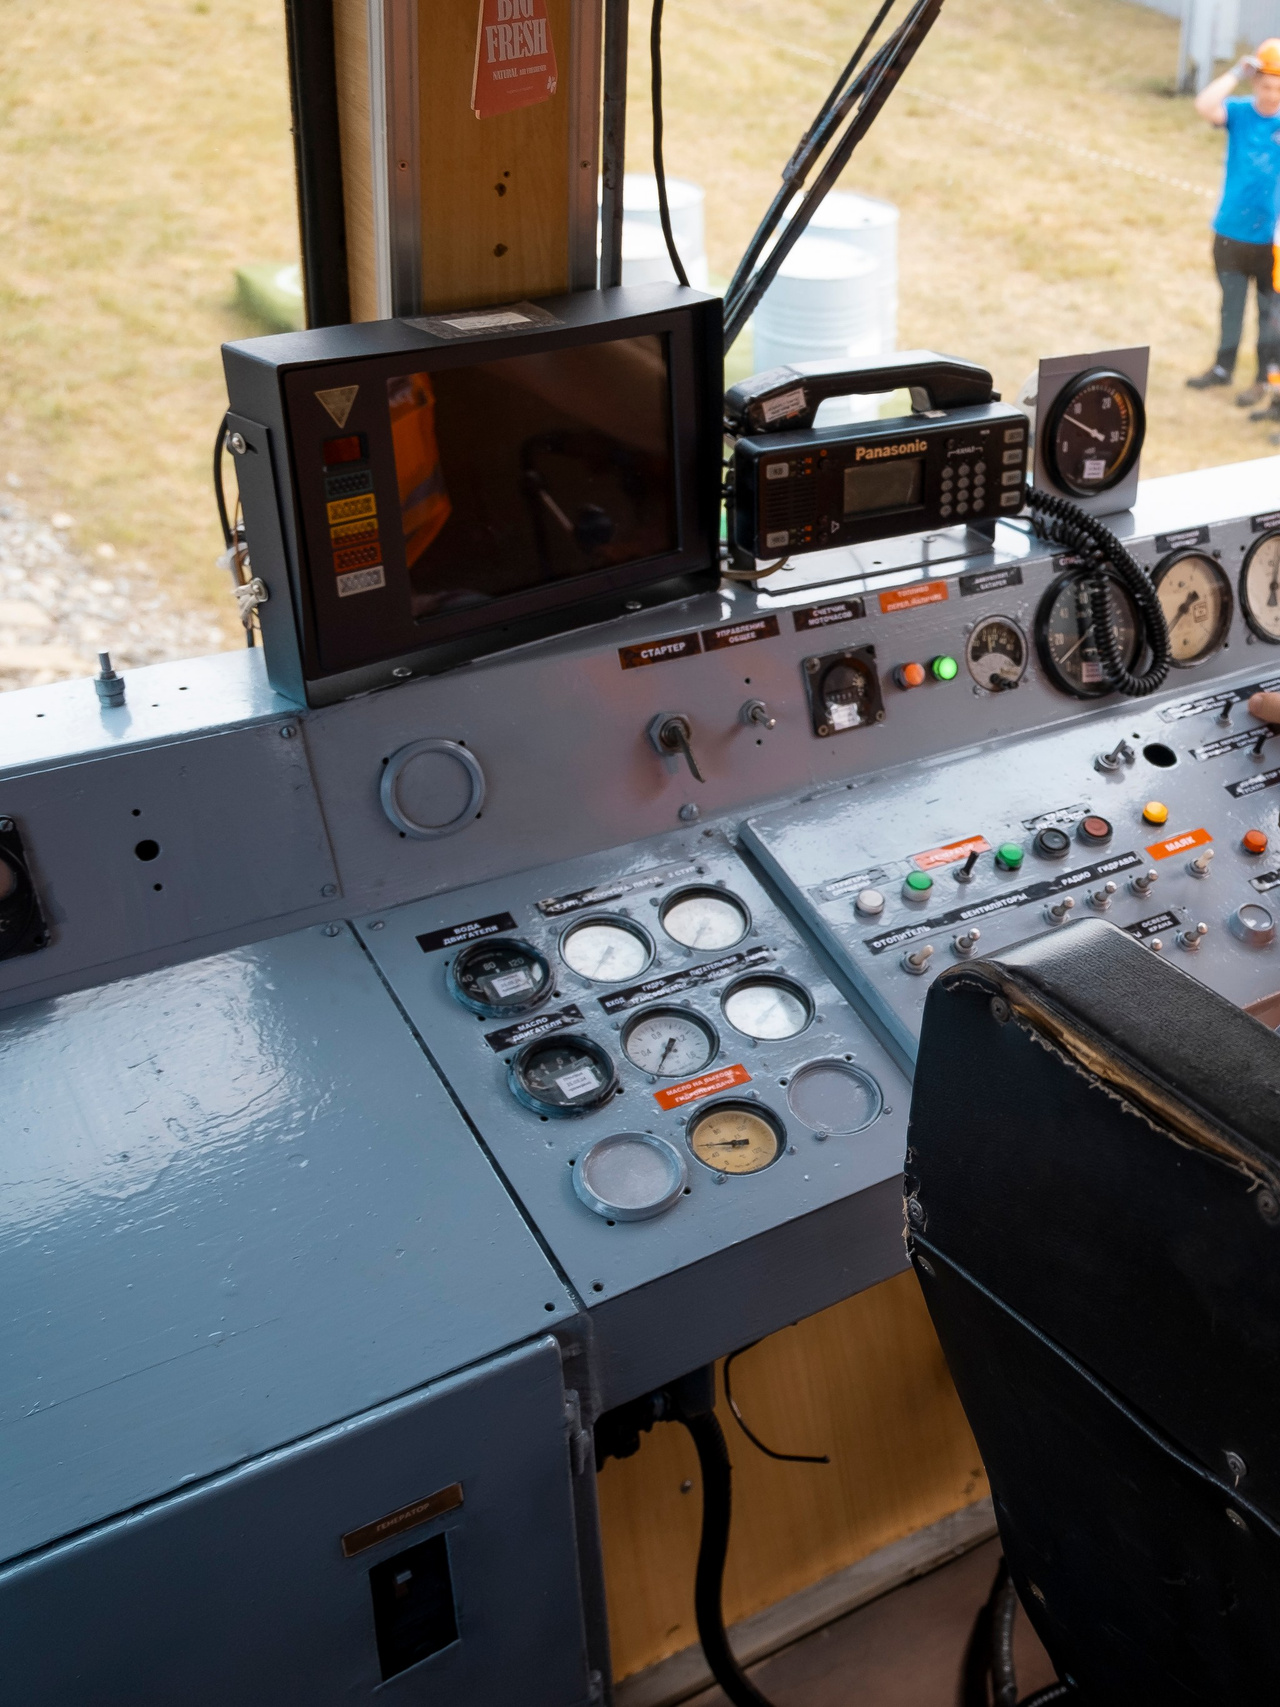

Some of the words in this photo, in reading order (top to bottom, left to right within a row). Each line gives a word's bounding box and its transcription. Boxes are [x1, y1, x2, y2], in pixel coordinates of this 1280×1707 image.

[485, 18, 548, 63] FRESH
[493, 68, 518, 80] NATURAL
[855, 439, 928, 461] Panasonic
[716, 621, 766, 639] УПРАВЛЕНИЕ
[728, 631, 757, 645] ОБЩЕЕ
[640, 641, 686, 660] СТАРТЕР
[1164, 835, 1197, 853] МАЯК
[1061, 870, 1092, 886] РАДИО
[961, 893, 1028, 919] ВЕНТИЛЯТОРЫ
[443, 925, 499, 946] ДВИГАТЕЛЯ
[454, 922, 480, 935] ВОДА
[1148, 920, 1174, 934] КРАНА
[872, 924, 931, 949] ОТОПИТЕЛЬ
[483, 961, 496, 971] 80
[509, 957, 525, 967] 120
[462, 974, 474, 983] 40
[604, 997, 625, 1008] ВХОД
[631, 984, 688, 1005] ТРАНСФОРМАТОР
[512, 1019, 562, 1043] ДВИГАТЕЛЯ
[517, 1016, 548, 1032] МАСЛО
[556, 1057, 563, 1065] 6
[666, 1084, 691, 1096] МАСЛО
[704, 1070, 733, 1084] ВЫХОДЕ
[675, 1077, 735, 1103] ГИДРОПЕРЕДАЧИ
[376, 1502, 430, 1532] ГЕНЕРАТОР
